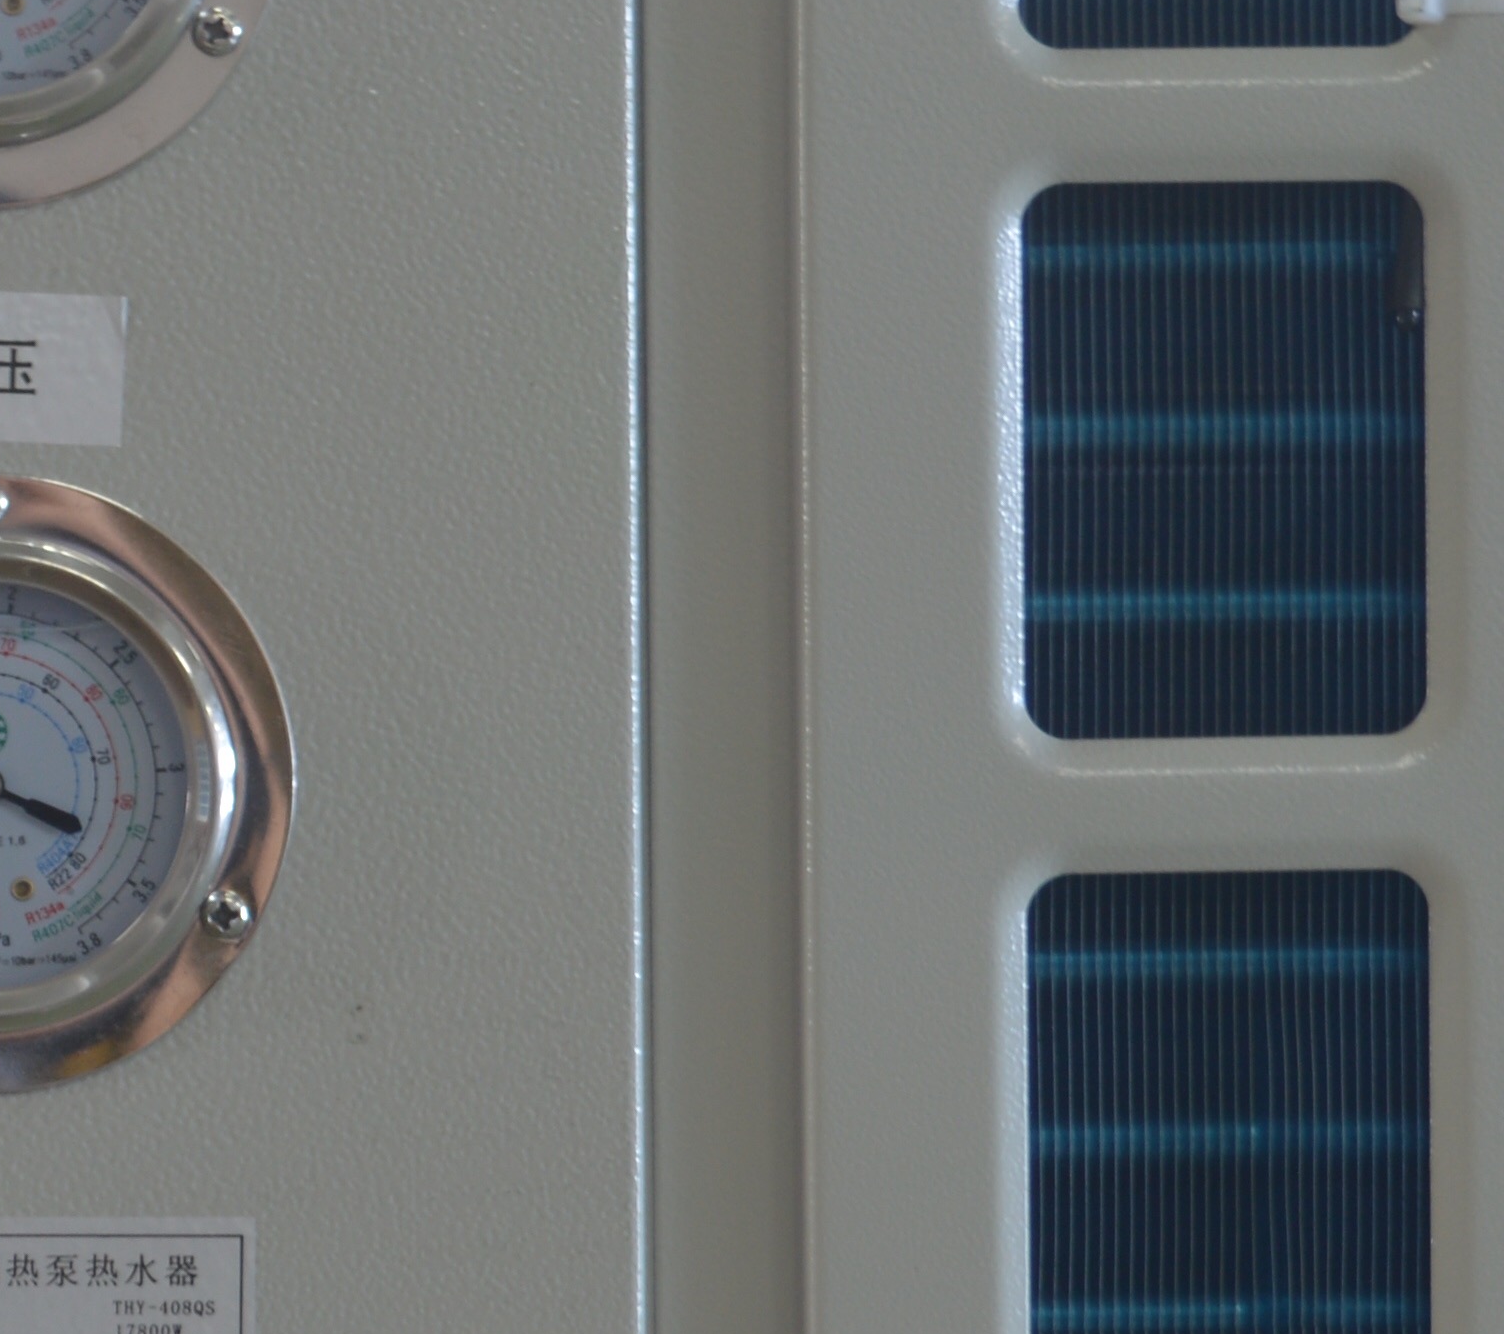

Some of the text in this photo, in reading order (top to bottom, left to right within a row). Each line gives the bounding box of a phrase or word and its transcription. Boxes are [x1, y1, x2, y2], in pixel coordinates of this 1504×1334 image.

[7, 589, 17, 601] 2
[1, 638, 16, 651] 70
[112, 640, 138, 665] 2.5
[42, 677, 60, 690] 60
[95, 749, 110, 765] 70
[36, 841, 74, 874] R404A
[71, 853, 86, 870] 80
[47, 870, 72, 891] R22
[133, 878, 156, 902] 3.5
[24, 901, 65, 925] R134a
[32, 917, 74, 941] R407C
[77, 934, 101, 954] 3.8
[113, 1300, 216, 1318] THY-408QS
